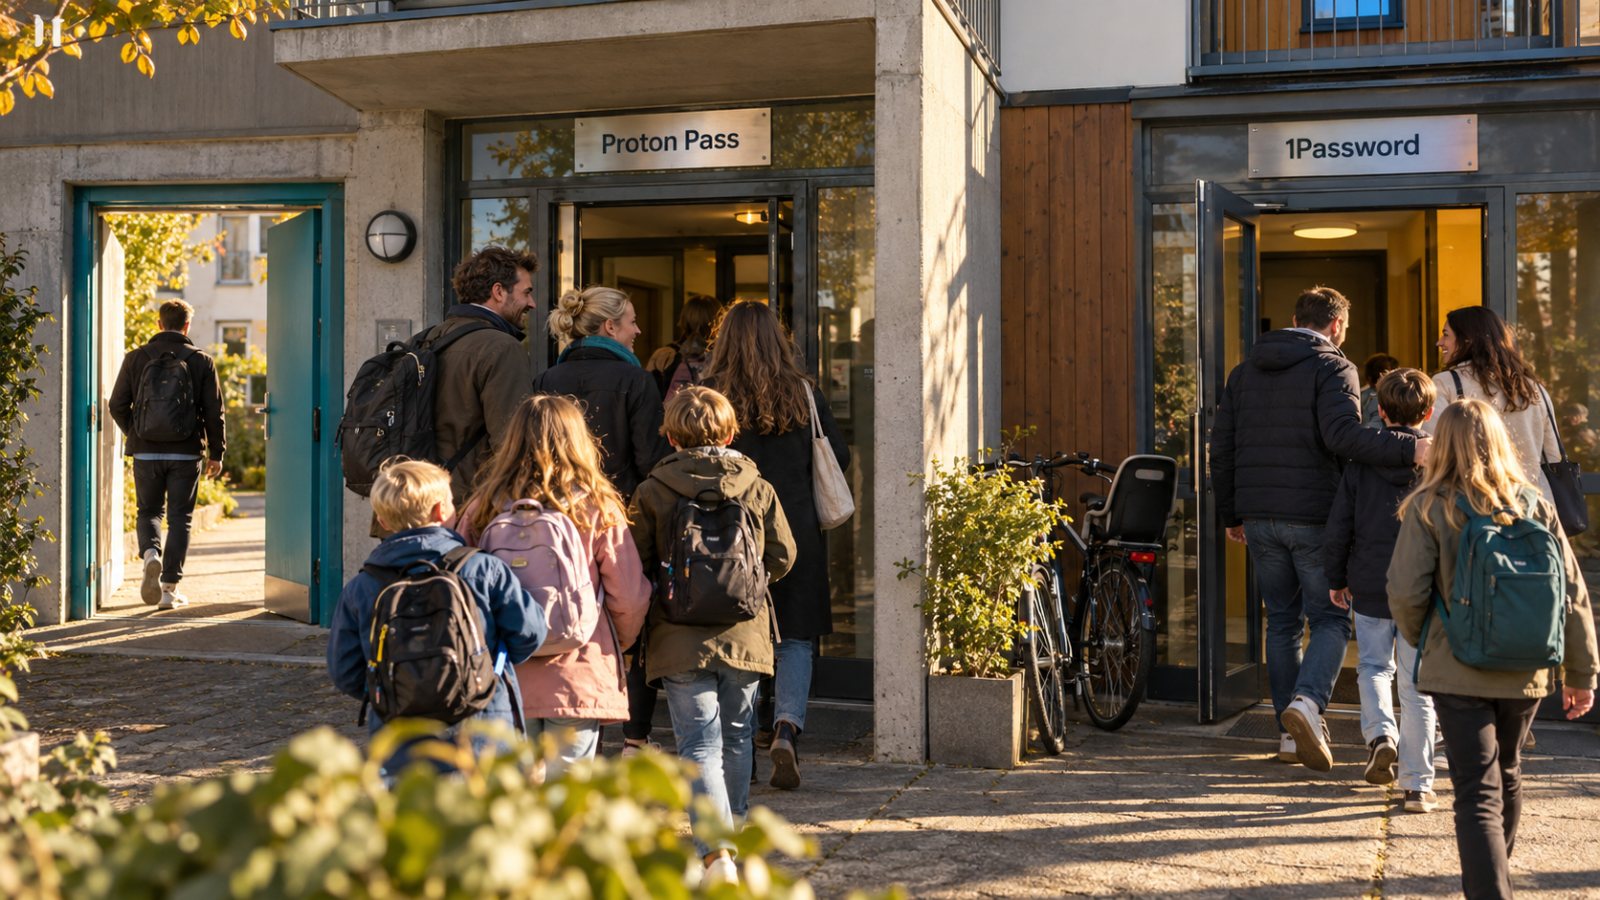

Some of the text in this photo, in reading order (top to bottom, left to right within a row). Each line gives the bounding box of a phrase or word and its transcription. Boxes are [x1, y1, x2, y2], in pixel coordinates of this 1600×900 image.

[602, 129, 740, 154] Proton Pass
[1285, 133, 1420, 159] 1Password
